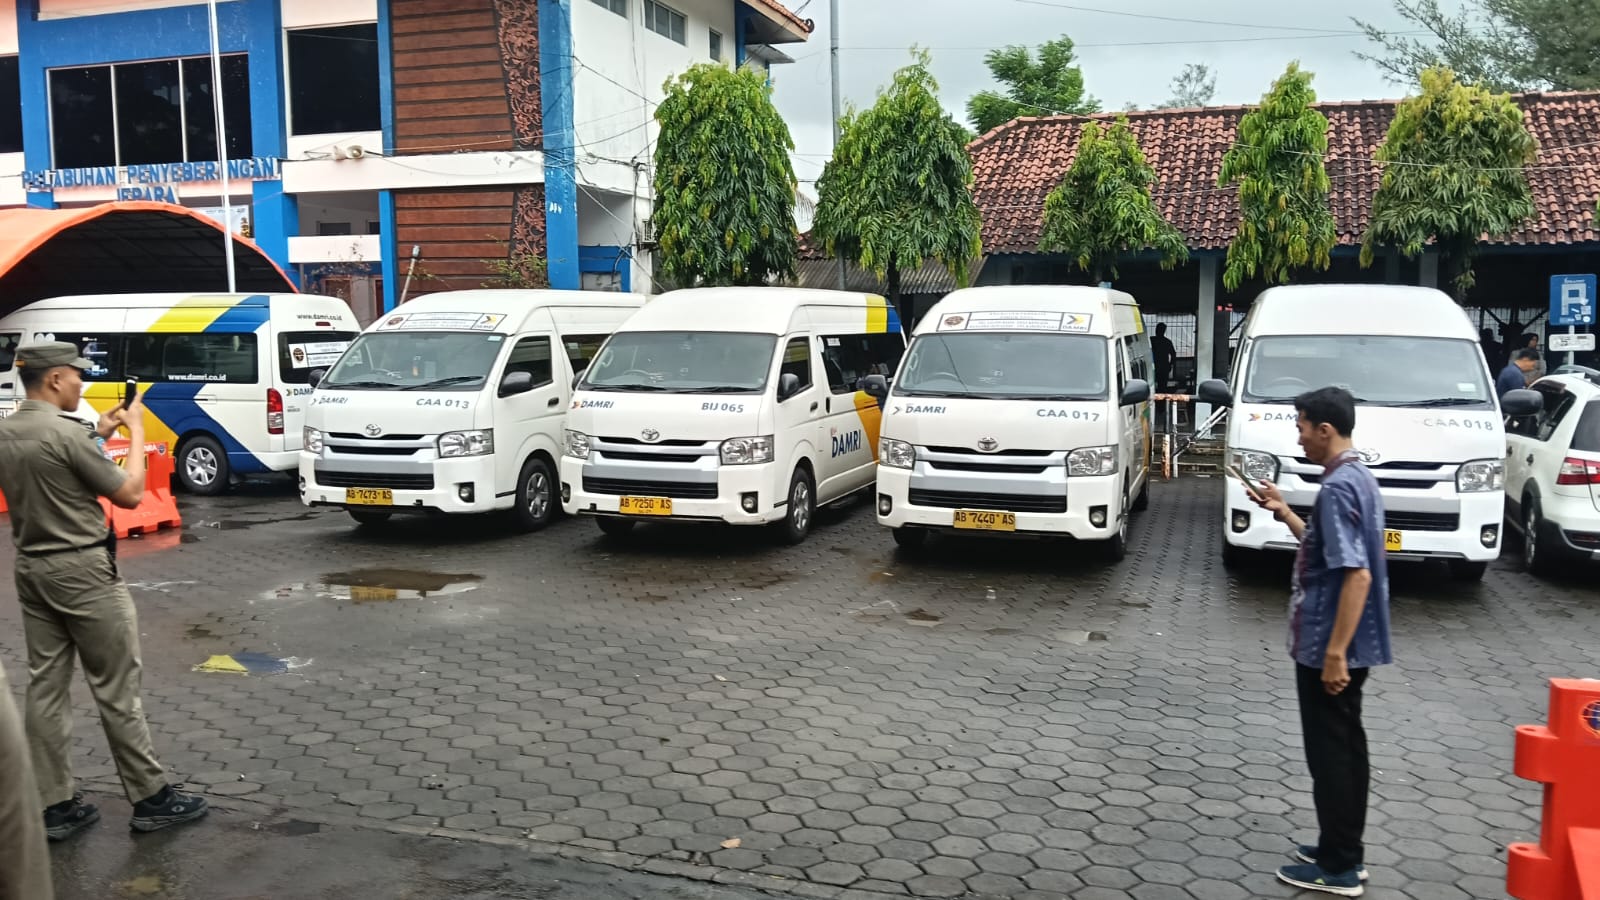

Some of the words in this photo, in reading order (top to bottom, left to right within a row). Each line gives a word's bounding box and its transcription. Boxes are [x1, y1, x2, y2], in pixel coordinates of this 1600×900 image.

[22, 166, 116, 188] PELABUHAN
[127, 158, 275, 184] PENYEBERNGAN
[416, 398, 441, 406] CAA
[445, 398, 470, 409] 013
[581, 400, 614, 408] DAMRI
[701, 402, 717, 411] BIJ
[720, 403, 744, 413] 065
[905, 405, 946, 414] DAMRI
[1036, 408, 1068, 418] CAA
[1072, 410, 1100, 422] 017
[1264, 412, 1299, 421] DAM
[1423, 418, 1459, 427] CAA
[1463, 420, 1493, 431] 018
[832, 429, 861, 458] DAMRI
[621, 498, 630, 507] AB
[634, 499, 654, 508] 7250
[660, 500, 671, 509] AS
[955, 512, 966, 522] AB
[970, 513, 995, 524] 7440
[1002, 515, 1014, 525] AS
[1386, 533, 1401, 544] AS
